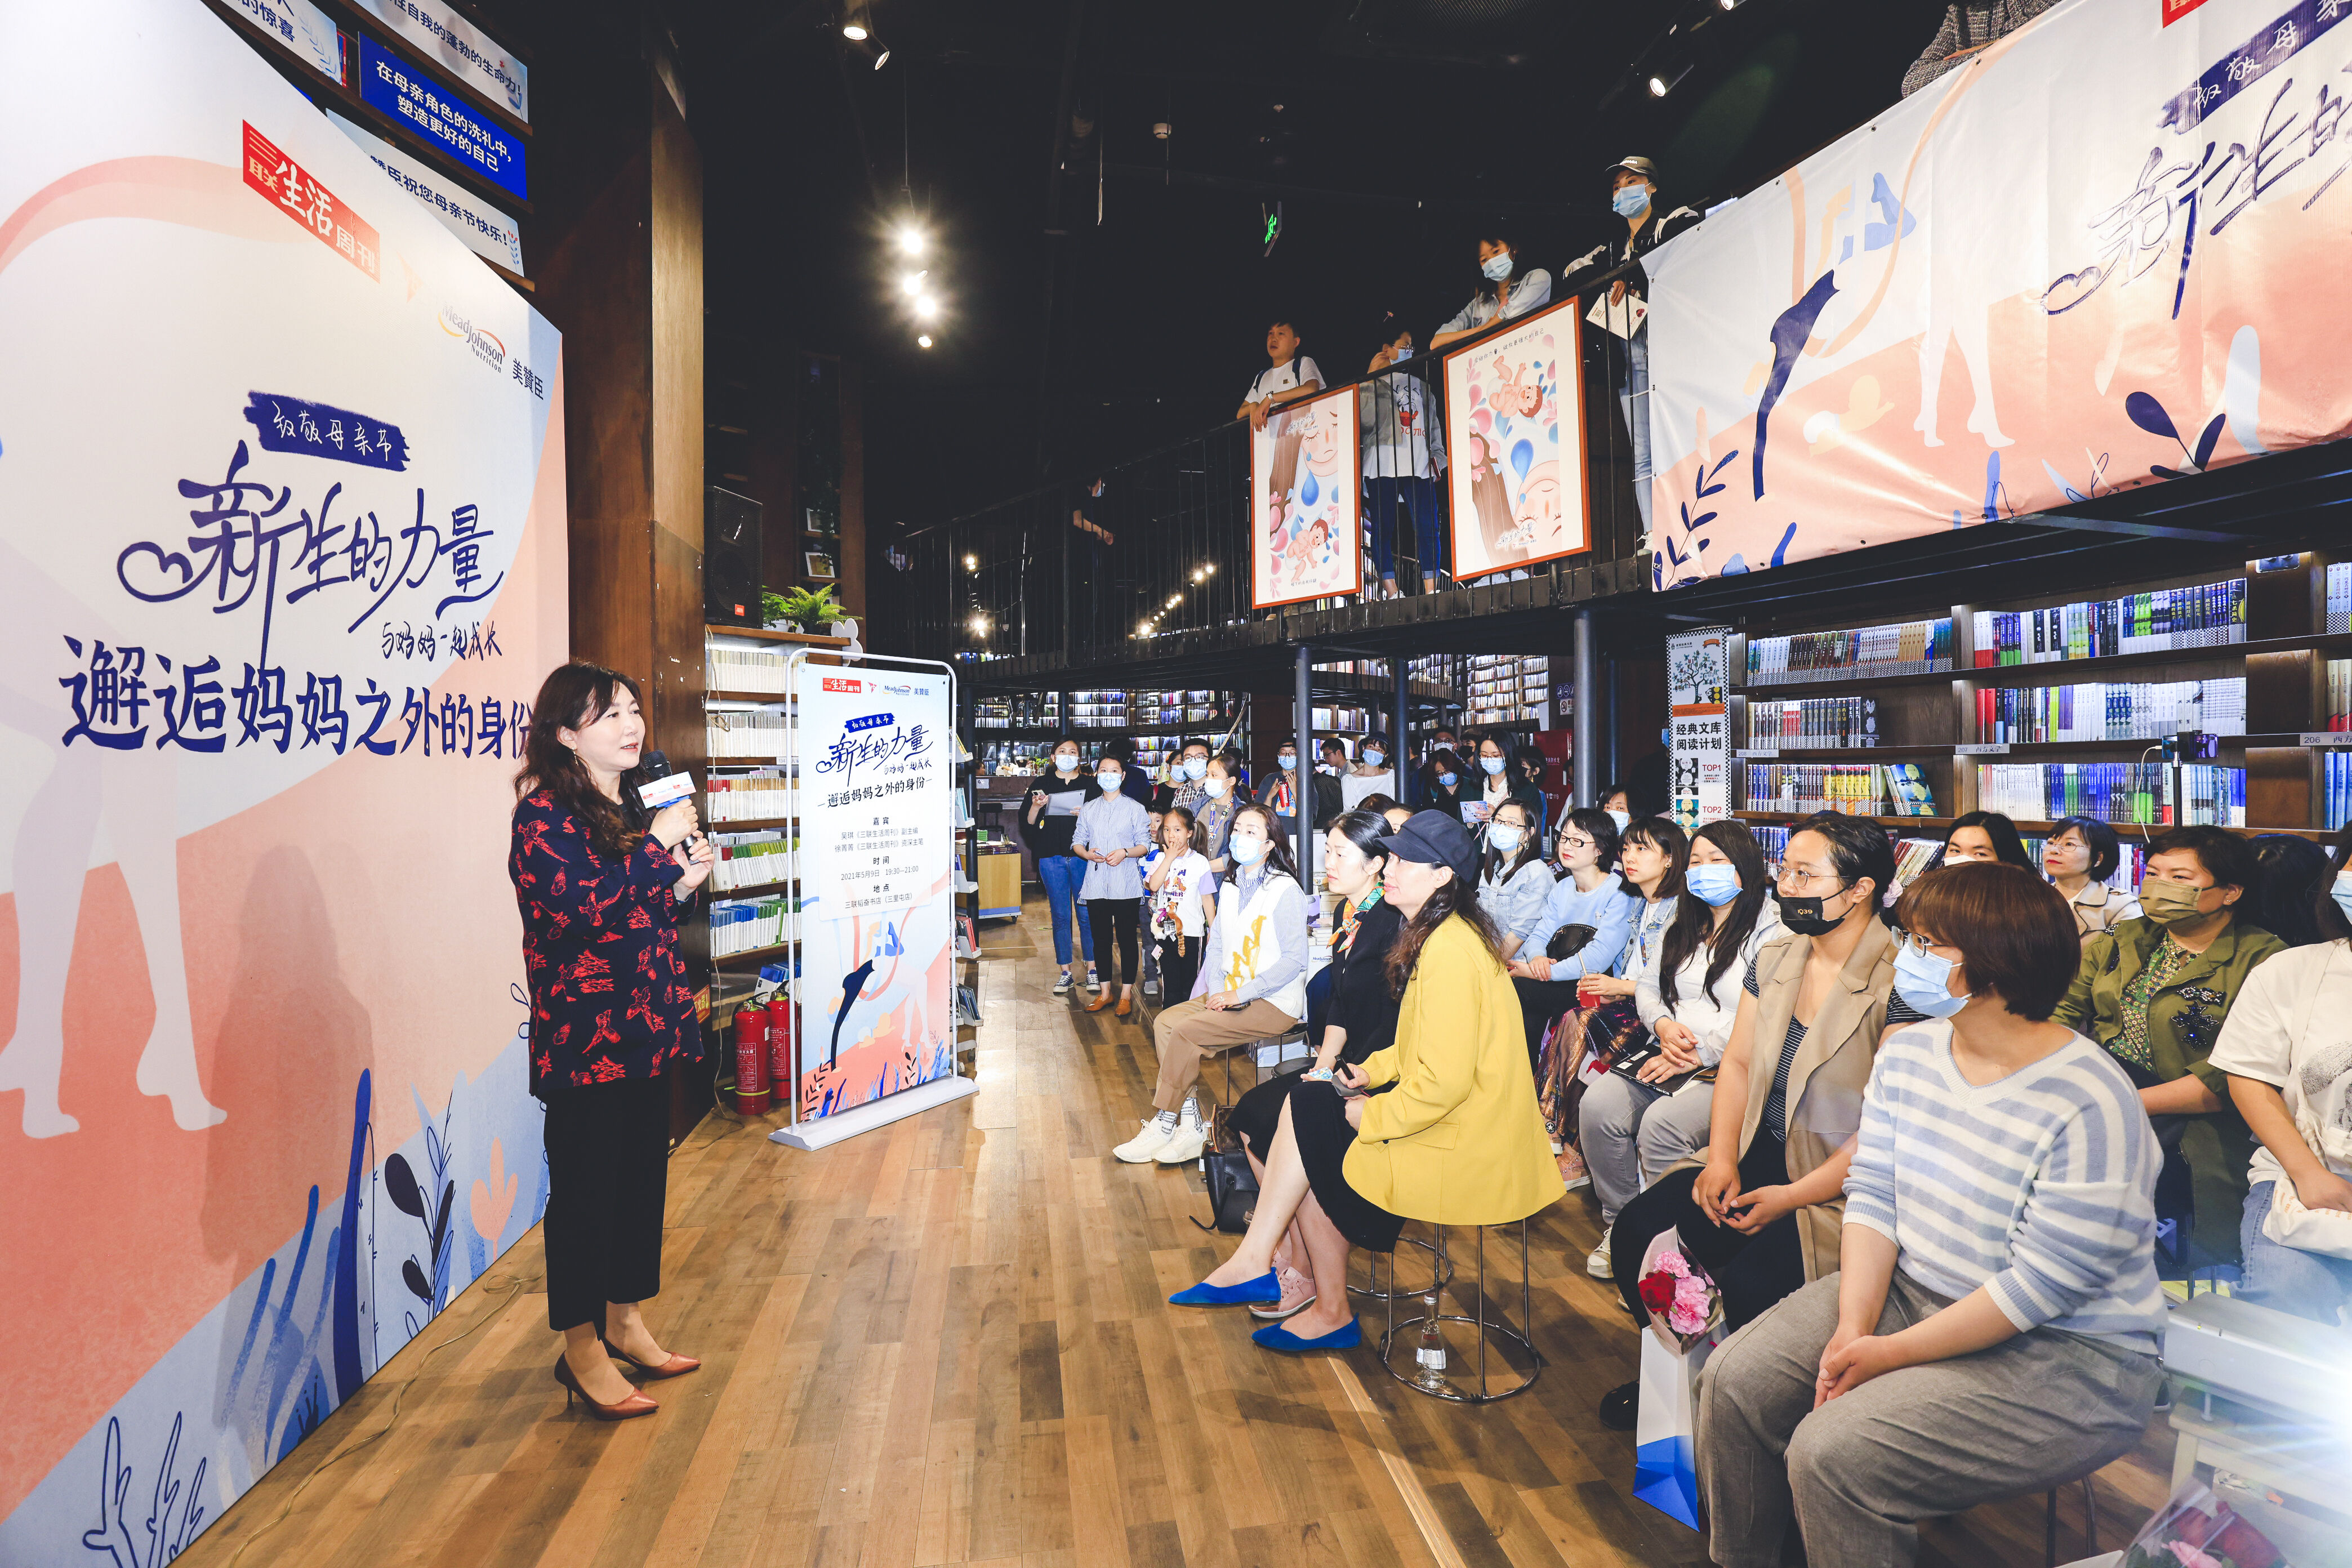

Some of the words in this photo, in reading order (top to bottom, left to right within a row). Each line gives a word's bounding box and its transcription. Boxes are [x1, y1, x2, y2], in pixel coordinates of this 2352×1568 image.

[376, 60, 511, 162] 在母亲角色的洗礼中，
[397, 94, 499, 172] 塑造更好的自己
[471, 344, 501, 373] Nutrition
[273, 400, 393, 461] 致敬母亲节
[117, 440, 504, 669] 新生的力量
[381, 620, 503, 661] 与妈妈一起成长
[59, 635, 533, 760] 邂逅妈妈之外的身份
[1676, 721, 1722, 735] 经典文库
[1677, 737, 1722, 751] 阅读计划
[816, 724, 933, 787] 新生的力量
[884, 759, 933, 775] 与妈妈一起成长
[841, 869, 880, 881] 2021年5月9日
[873, 856, 889, 865] 时间
[873, 884, 890, 893] 地点
